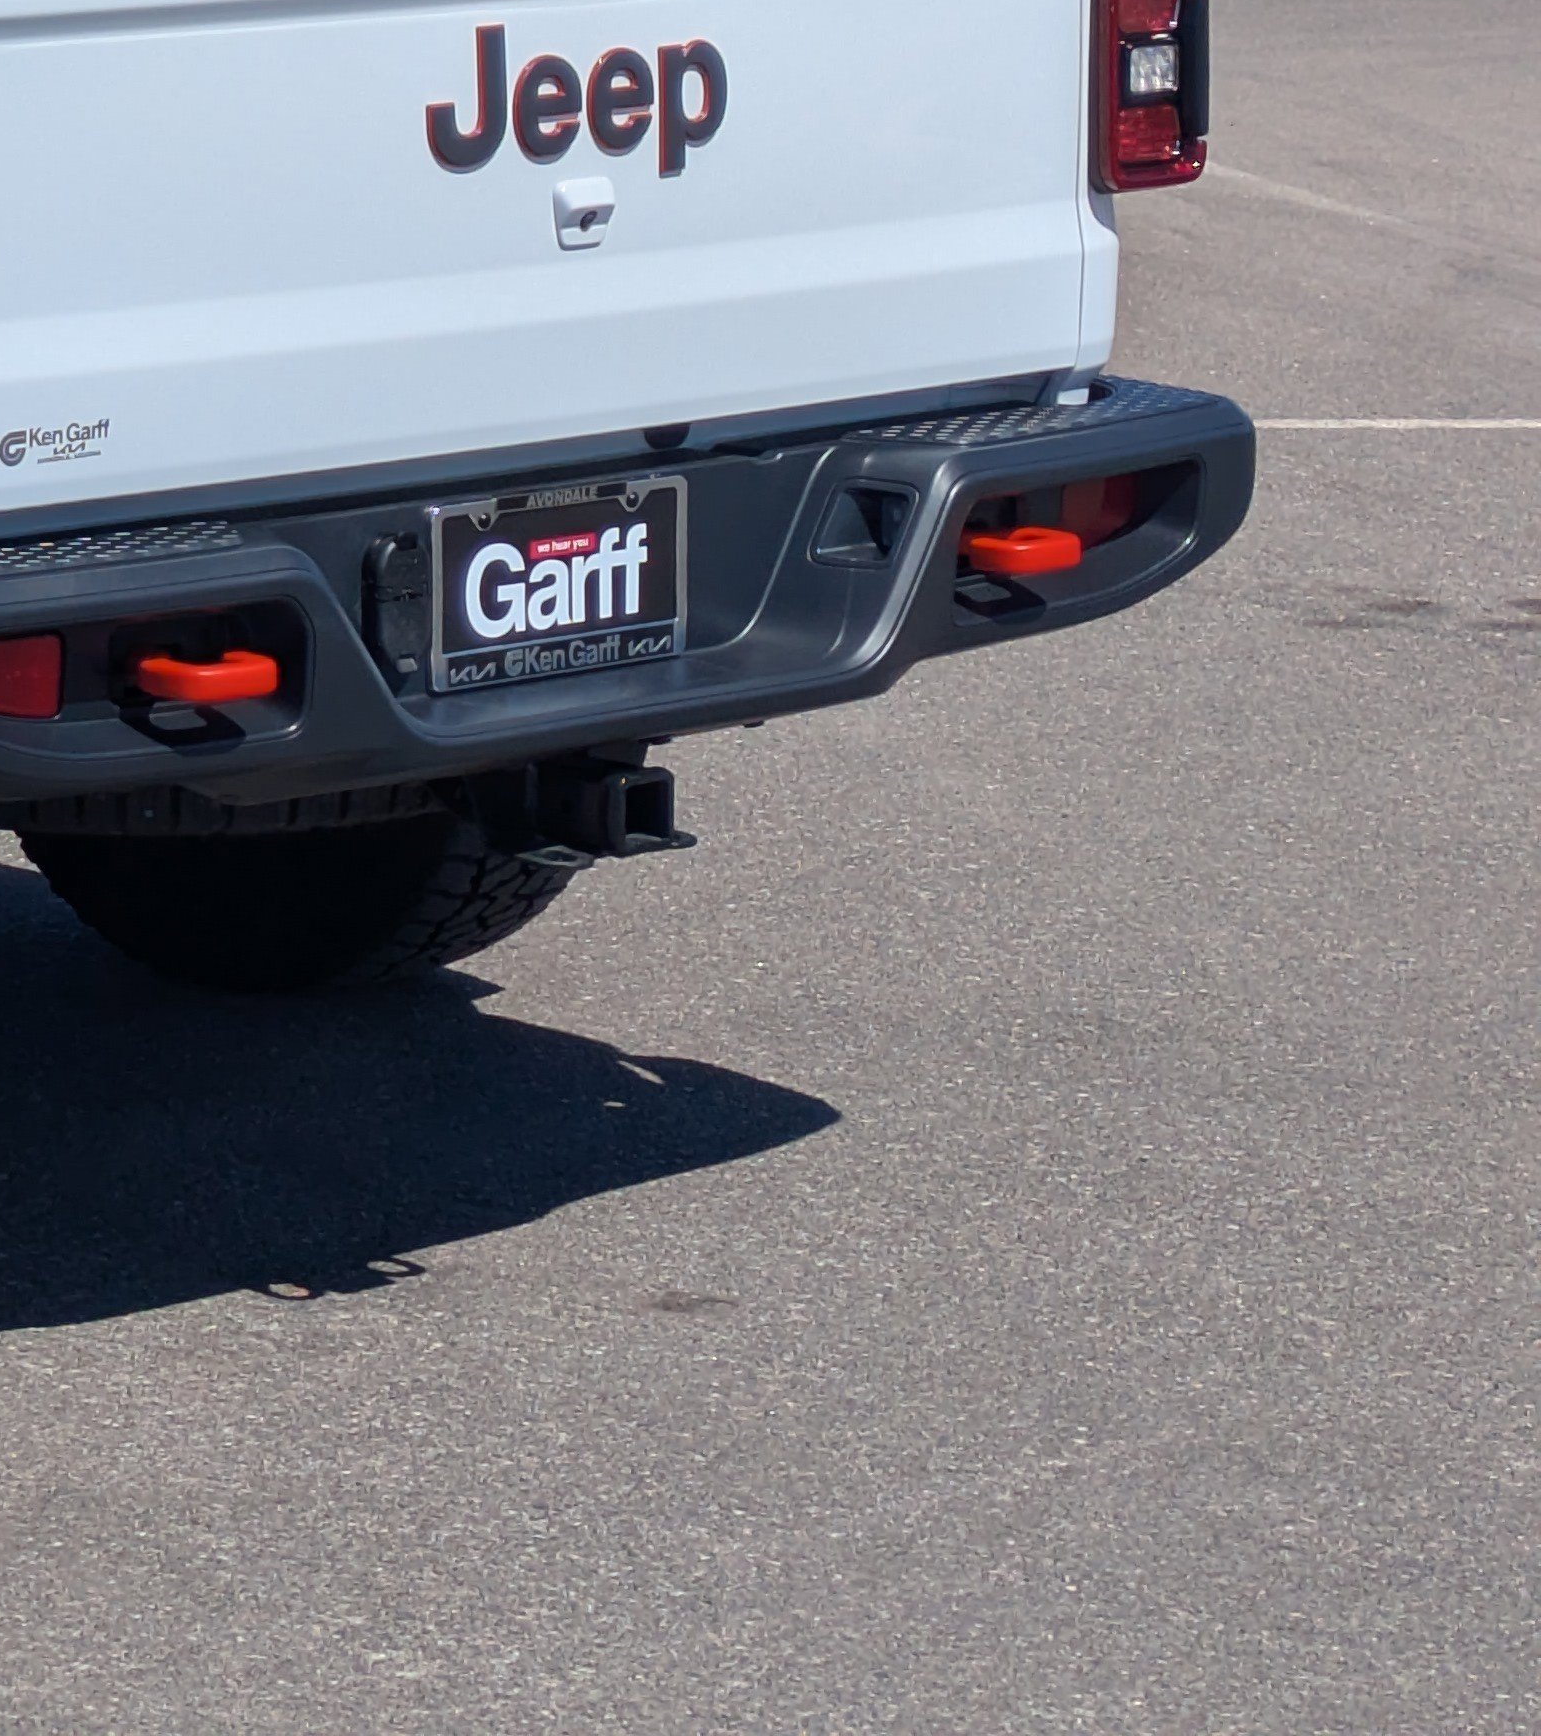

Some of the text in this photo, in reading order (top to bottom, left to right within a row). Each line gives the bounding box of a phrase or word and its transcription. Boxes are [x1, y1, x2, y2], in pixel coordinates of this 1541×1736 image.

[425, 23, 728, 179] Jeep
[29, 419, 109, 448] Ken Garff
[527, 486, 598, 509] AVONDALE
[538, 538, 589, 553] we hear you
[465, 522, 649, 639] Garff
[525, 647, 566, 676] Ken
[569, 635, 621, 666] Garff
